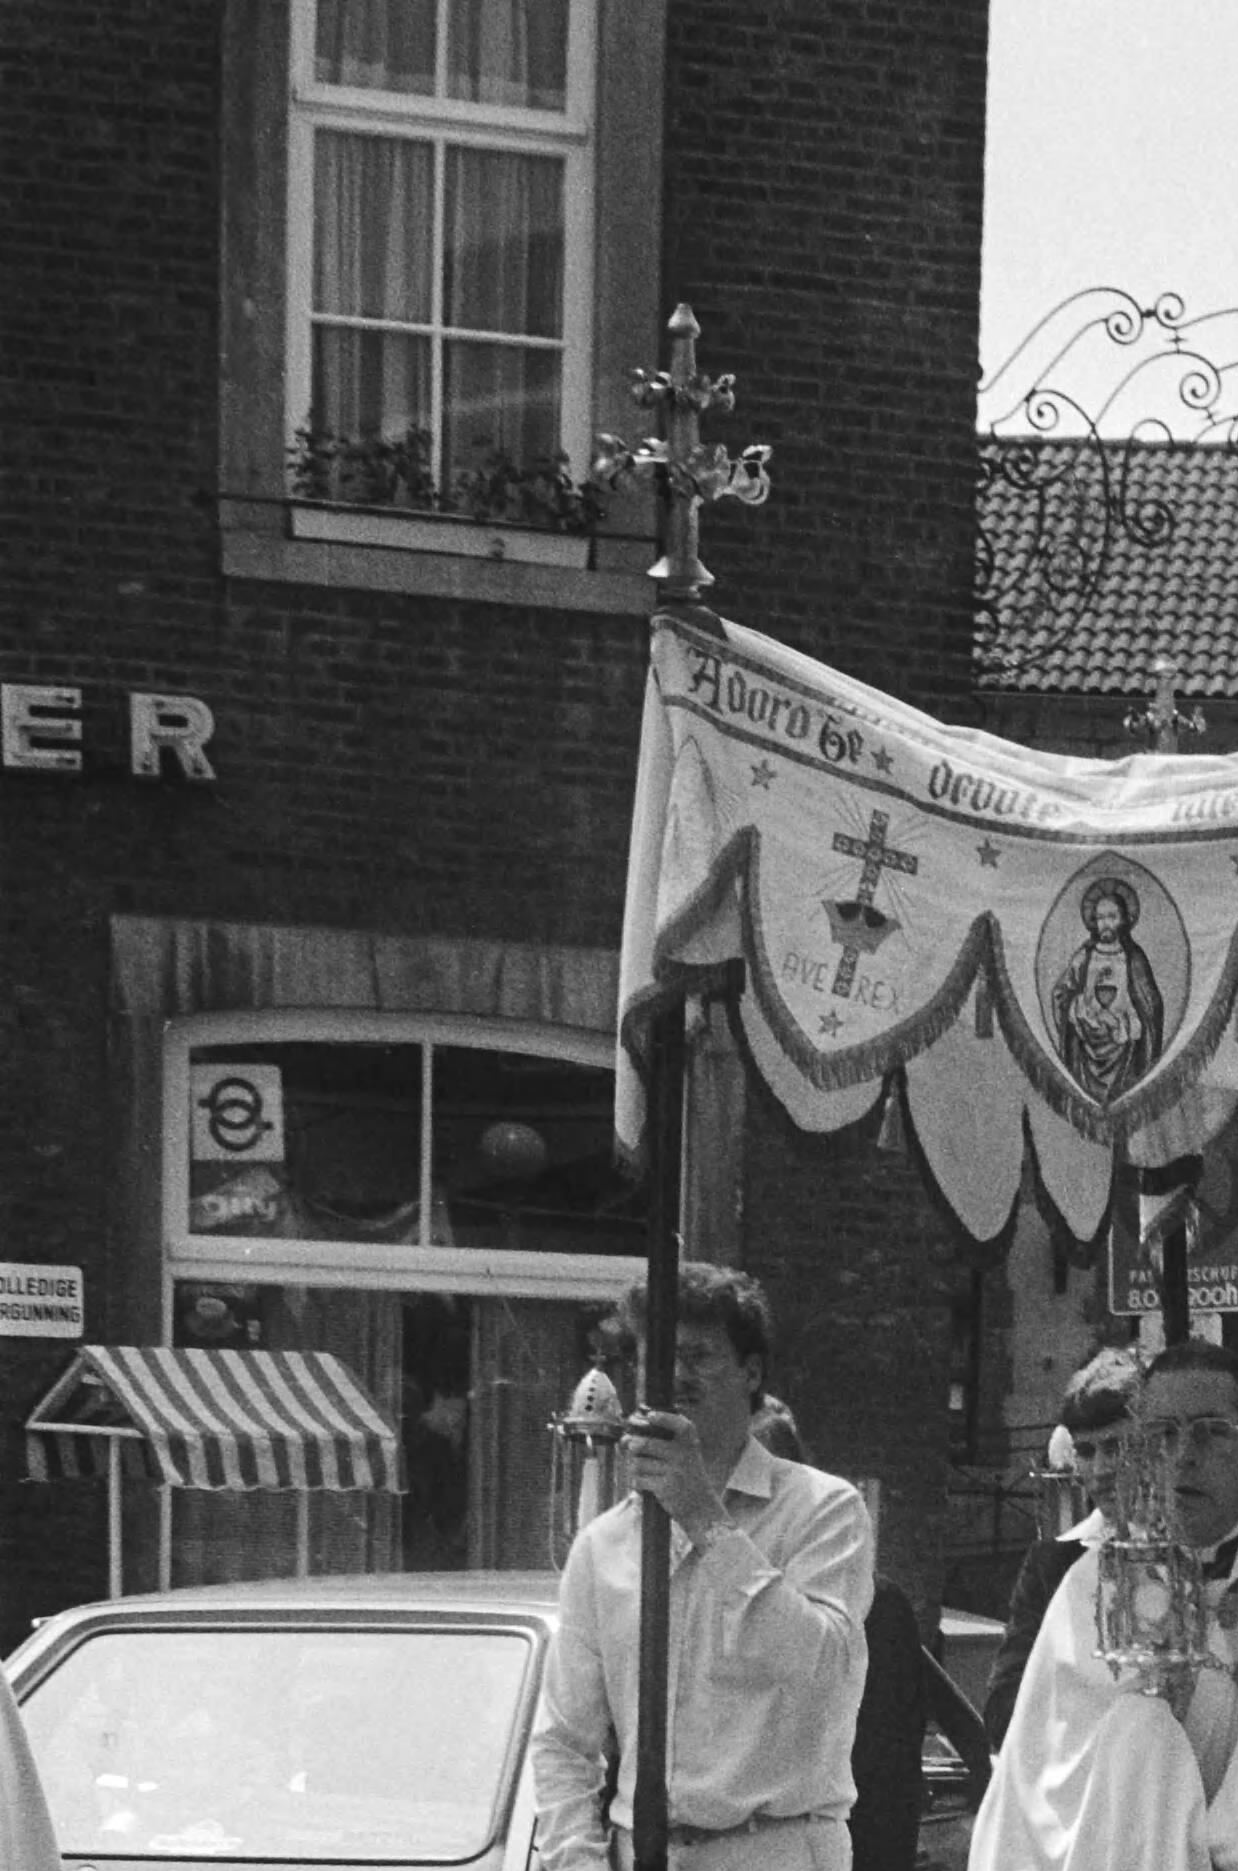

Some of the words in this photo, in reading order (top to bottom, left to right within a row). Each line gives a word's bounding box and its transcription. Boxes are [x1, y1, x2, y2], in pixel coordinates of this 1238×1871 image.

[1, 683, 217, 780] ER
[781, 951, 829, 993] AVE
[854, 975, 904, 1016] REX
